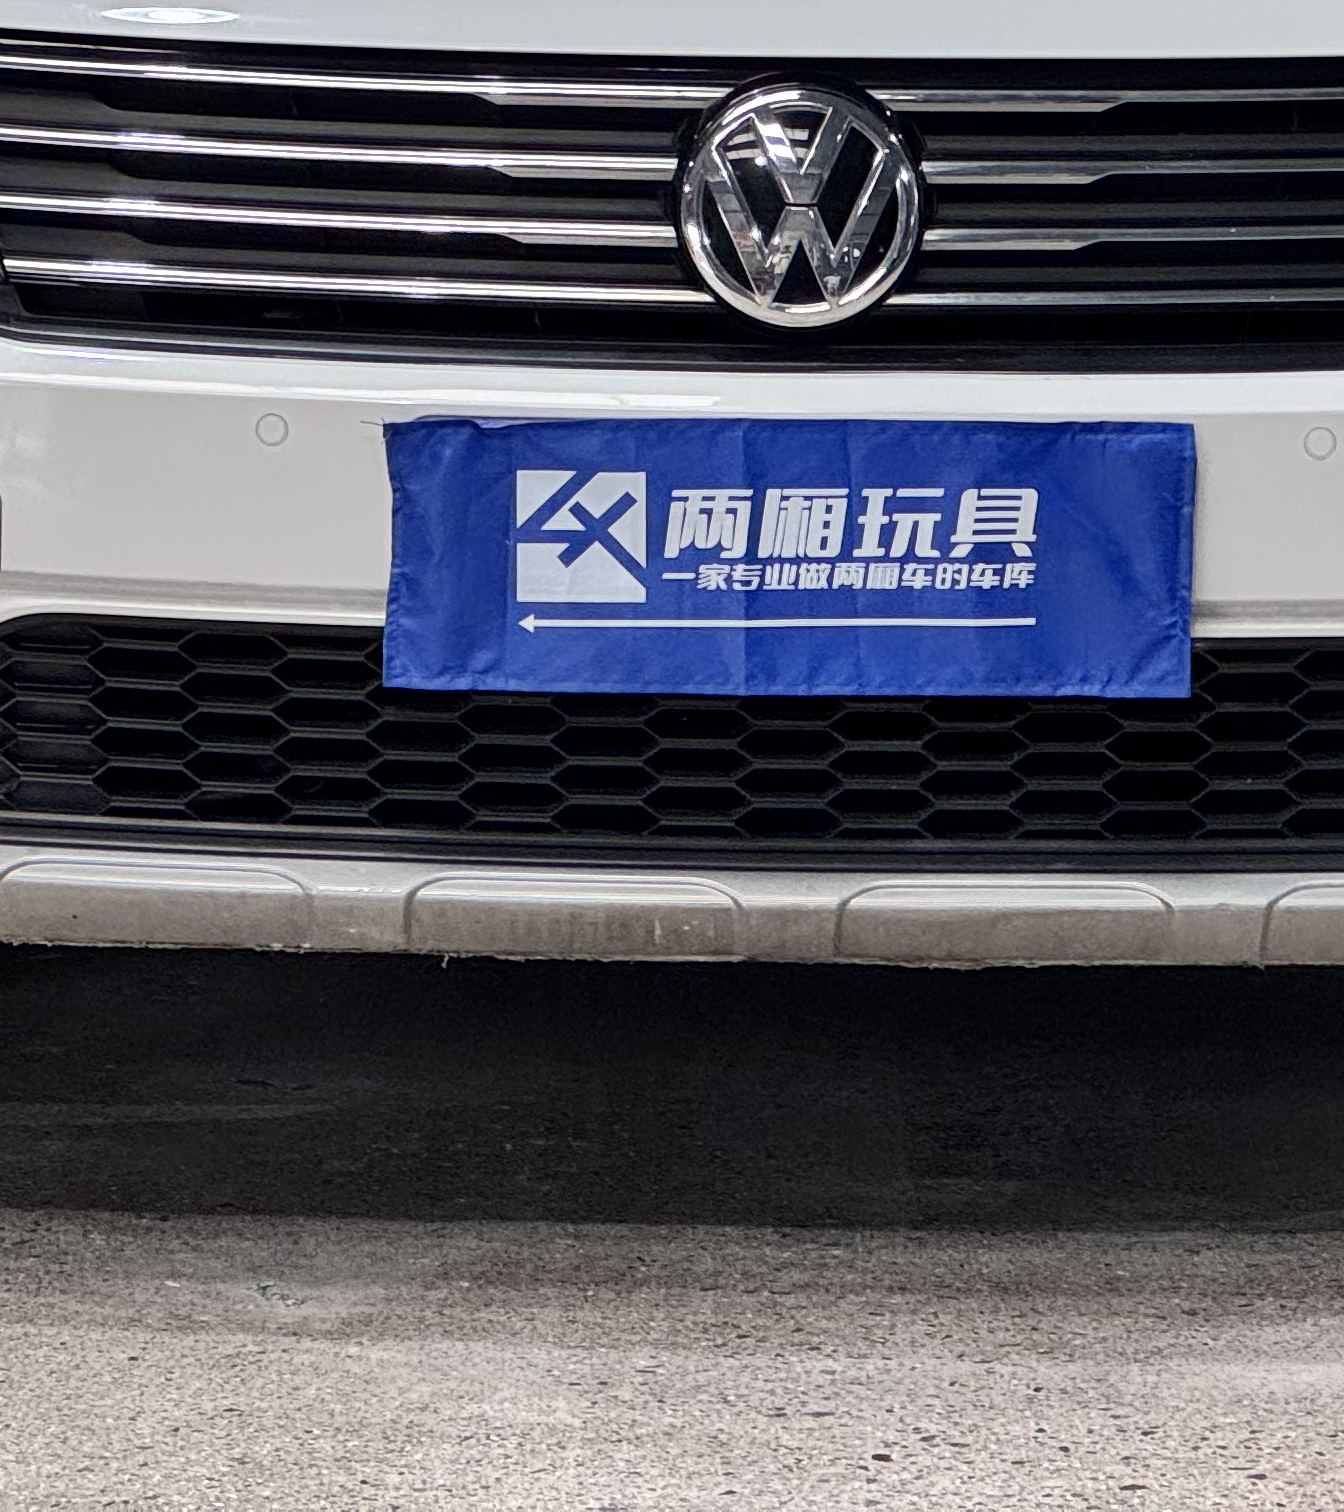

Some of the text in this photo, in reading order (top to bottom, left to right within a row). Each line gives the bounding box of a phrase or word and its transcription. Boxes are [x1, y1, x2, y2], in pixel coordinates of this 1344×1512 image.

[663, 488, 1039, 559] 两厢玩具
[661, 563, 1037, 590] 一家专业做两厢车的车库
